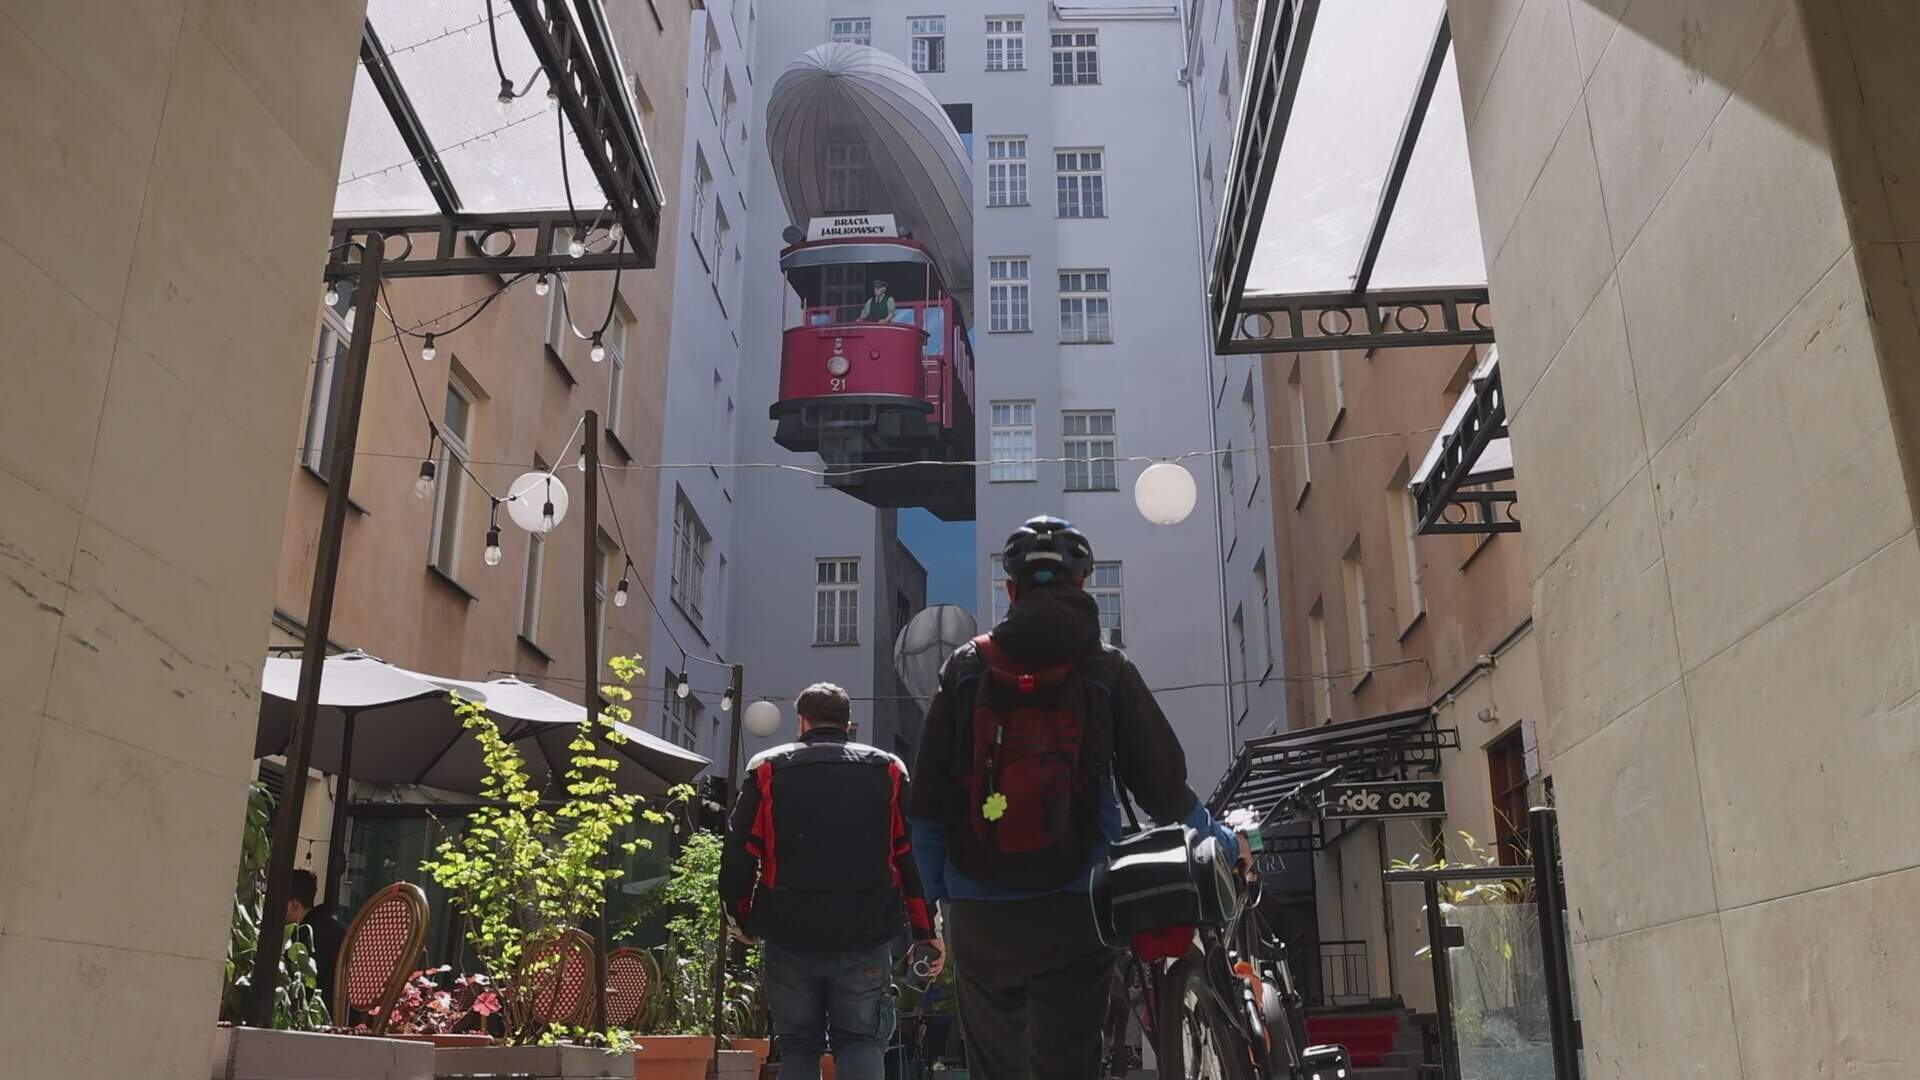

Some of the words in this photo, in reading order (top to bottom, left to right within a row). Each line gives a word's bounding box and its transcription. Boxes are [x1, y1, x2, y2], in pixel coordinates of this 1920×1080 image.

[834, 217, 869, 226] BRACIA
[821, 225, 885, 237] JABŁKOWSCY
[830, 378, 846, 391] 21
[1388, 791, 1432, 809] one
